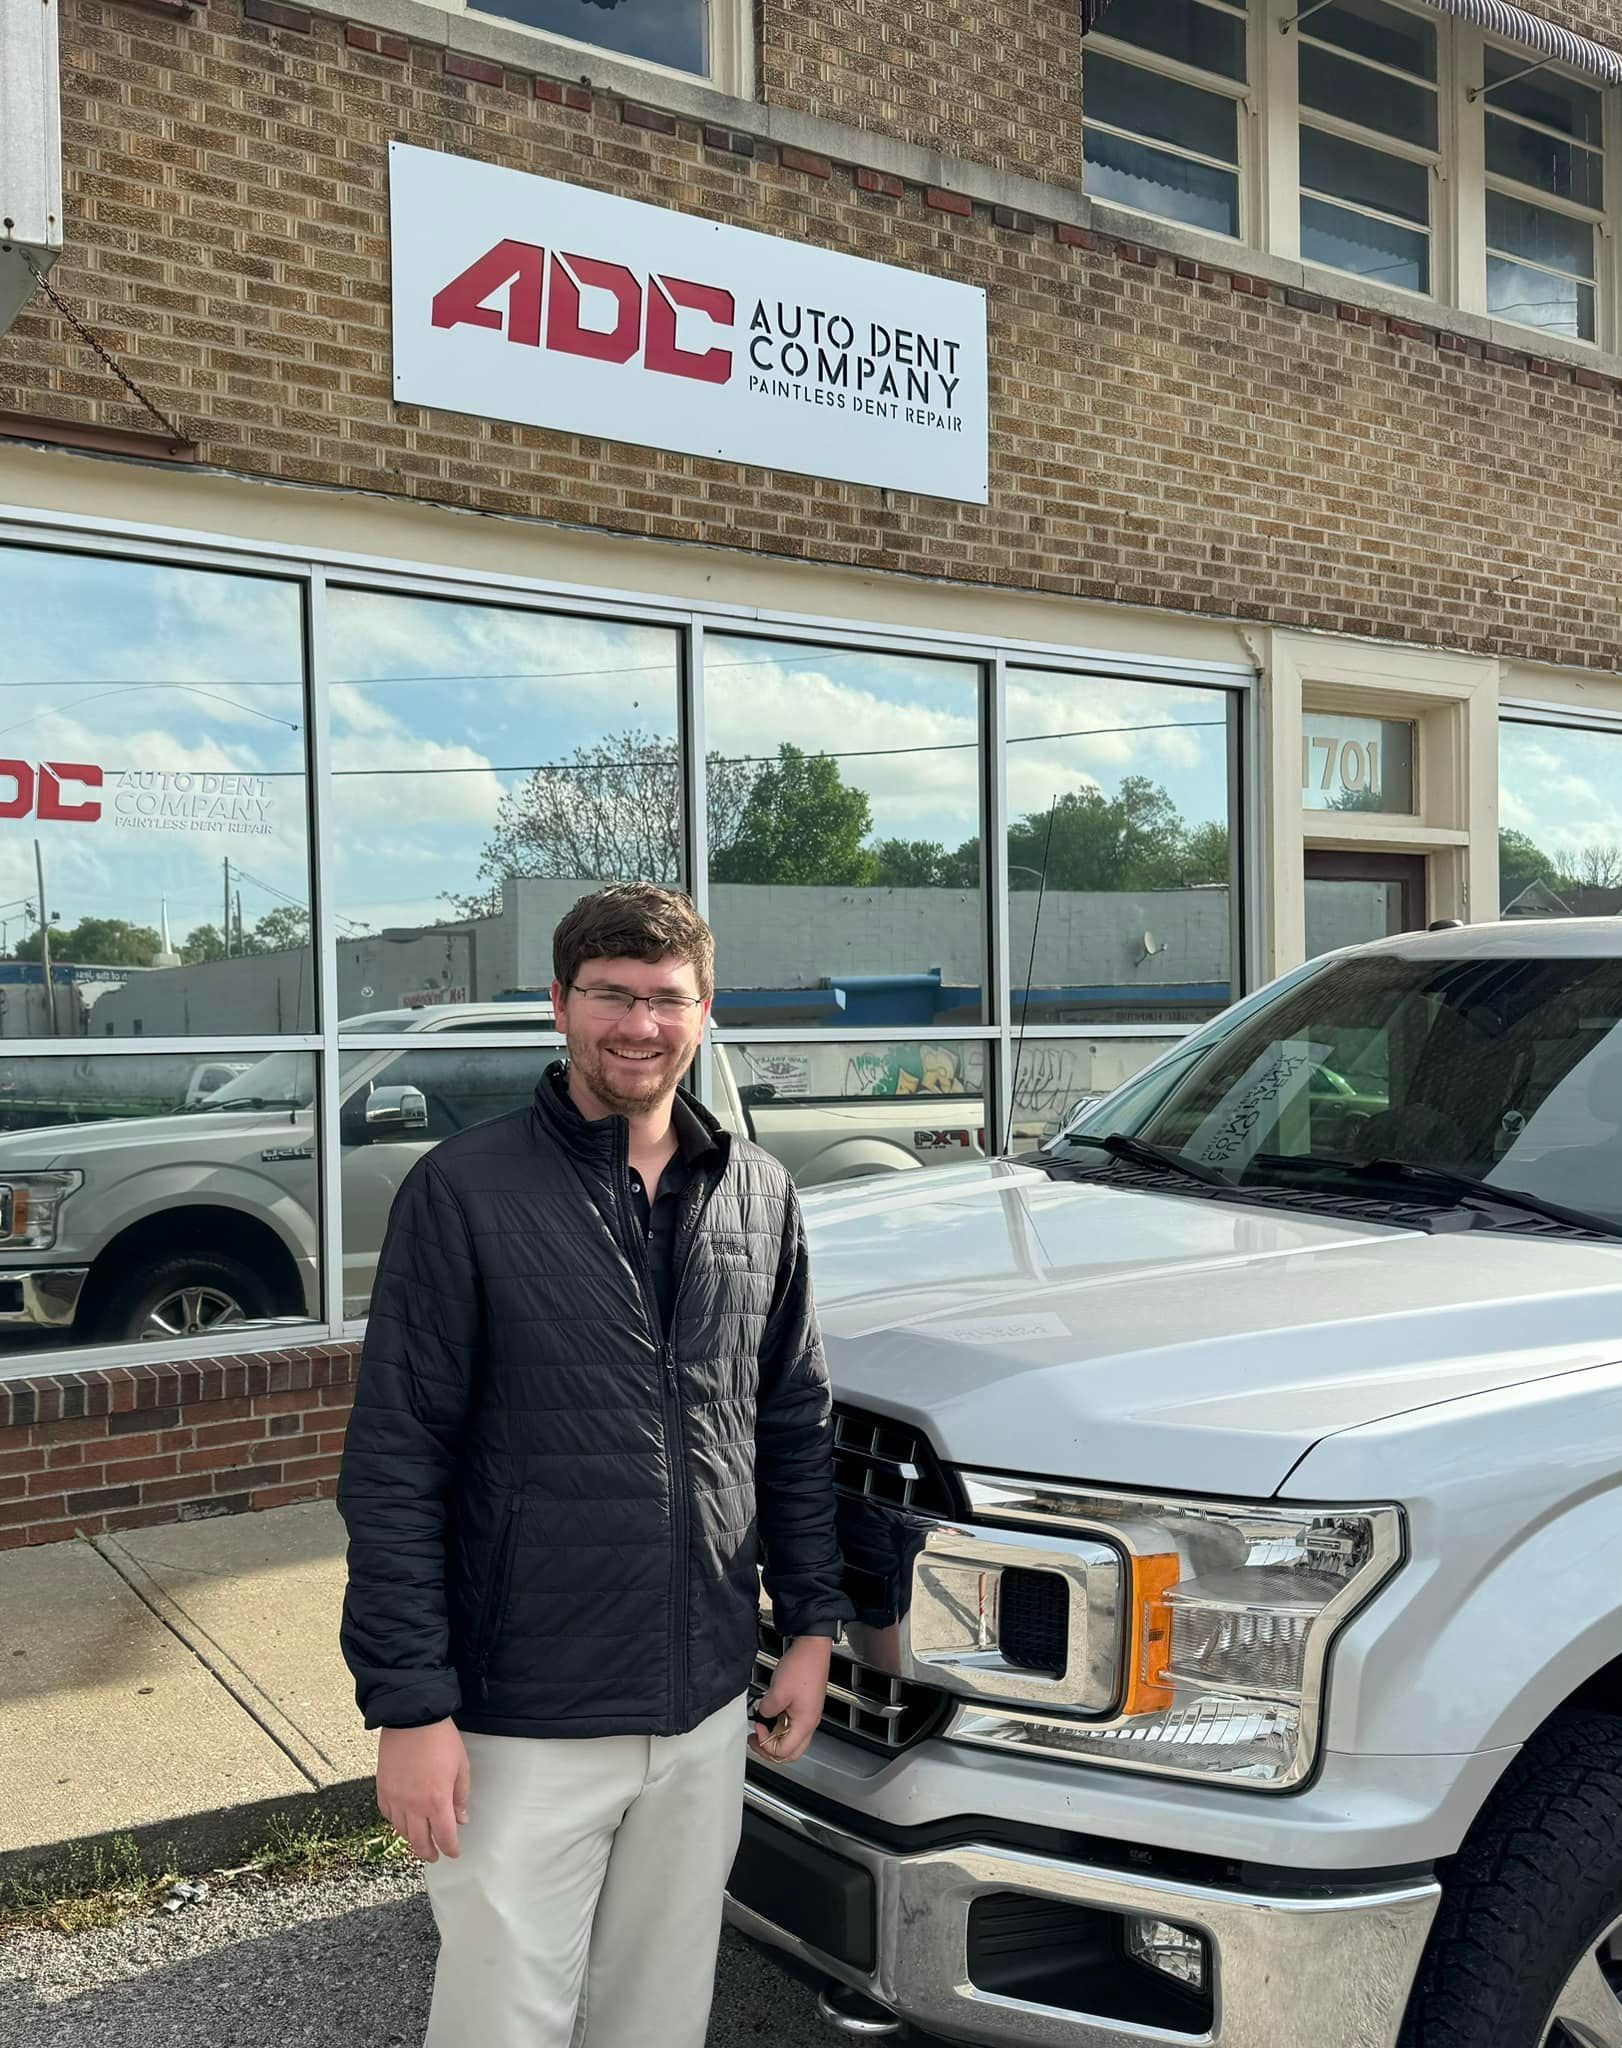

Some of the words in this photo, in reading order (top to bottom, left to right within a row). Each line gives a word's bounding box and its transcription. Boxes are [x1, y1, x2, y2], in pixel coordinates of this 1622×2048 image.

[431, 238, 736, 385] ADC
[749, 298, 855, 350] AUTO
[870, 322, 961, 375] DENT
[749, 335, 960, 410] COMPANY
[749, 375, 846, 409] PAINTLESS
[853, 396, 899, 420] DENT
[905, 406, 962, 433] REPAIR
[115, 768, 195, 794] AUTO
[201, 772, 273, 798] DENT
[1301, 735, 1378, 793] 1701
[113, 790, 274, 823] COMPANY
[114, 815, 188, 832] PAINTLESS
[189, 820, 228, 833] DENT
[227, 822, 273, 835] REPAIR
